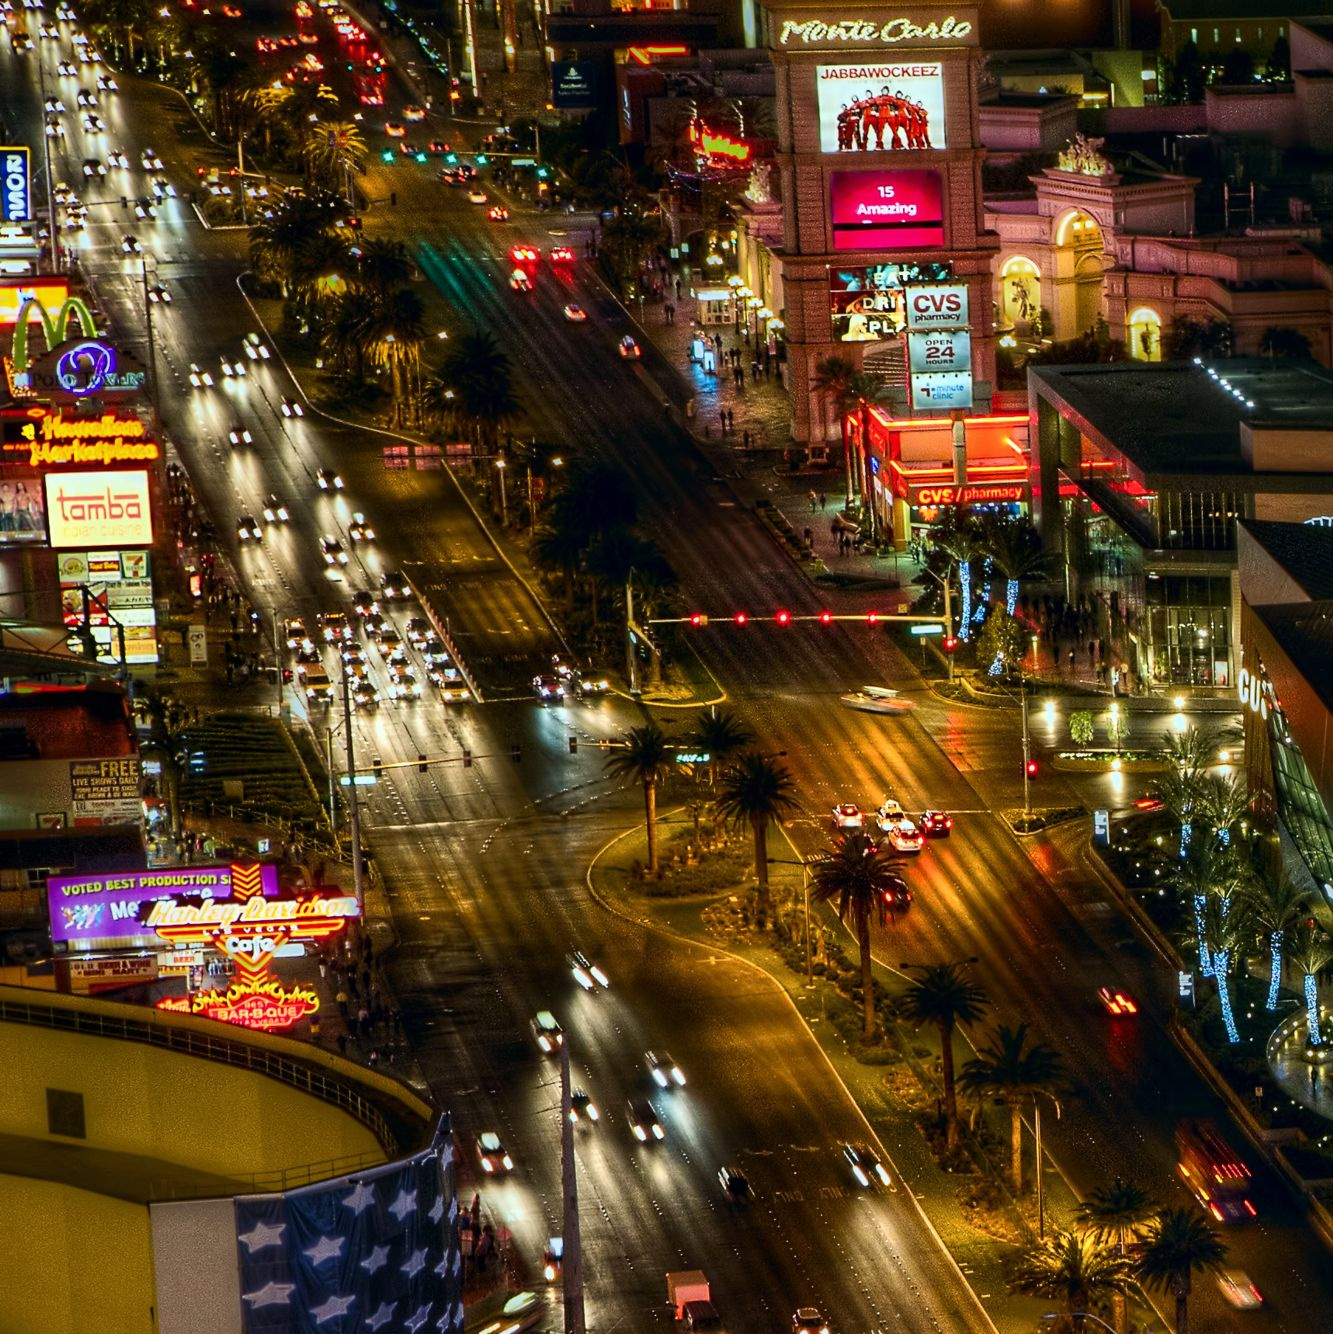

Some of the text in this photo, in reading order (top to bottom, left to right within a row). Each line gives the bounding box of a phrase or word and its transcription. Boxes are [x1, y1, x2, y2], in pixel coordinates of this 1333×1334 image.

[781, 16, 972, 44] Monte Carlo
[821, 65, 940, 80] JABBAWOCKEEZ
[877, 185, 895, 198] 15
[857, 202, 917, 216] Amazing
[913, 293, 961, 313] CVS
[914, 313, 961, 323] pharmacy
[925, 346, 955, 359] 24
[932, 391, 954, 400] clinic
[42, 414, 145, 440] Hawaiian
[29, 437, 160, 467] Marketplace
[918, 487, 954, 505] CVS
[964, 487, 1022, 502] pharmacy
[56, 486, 142, 522] tamba
[101, 761, 139, 777] FREE
[73, 776, 139, 786] LIVE SHOWS DAILY
[61, 882, 102, 897] VOTED
[105, 878, 136, 892] BEST
[139, 874, 217, 888] PRODUCTION
[146, 895, 361, 929] Harley-Davidson
[202, 925, 299, 935] LAS VEGAS
[225, 936, 275, 962] Cafe
[112, 968, 140, 976] MART
[217, 1006, 298, 1020] BAR-B-QUE
